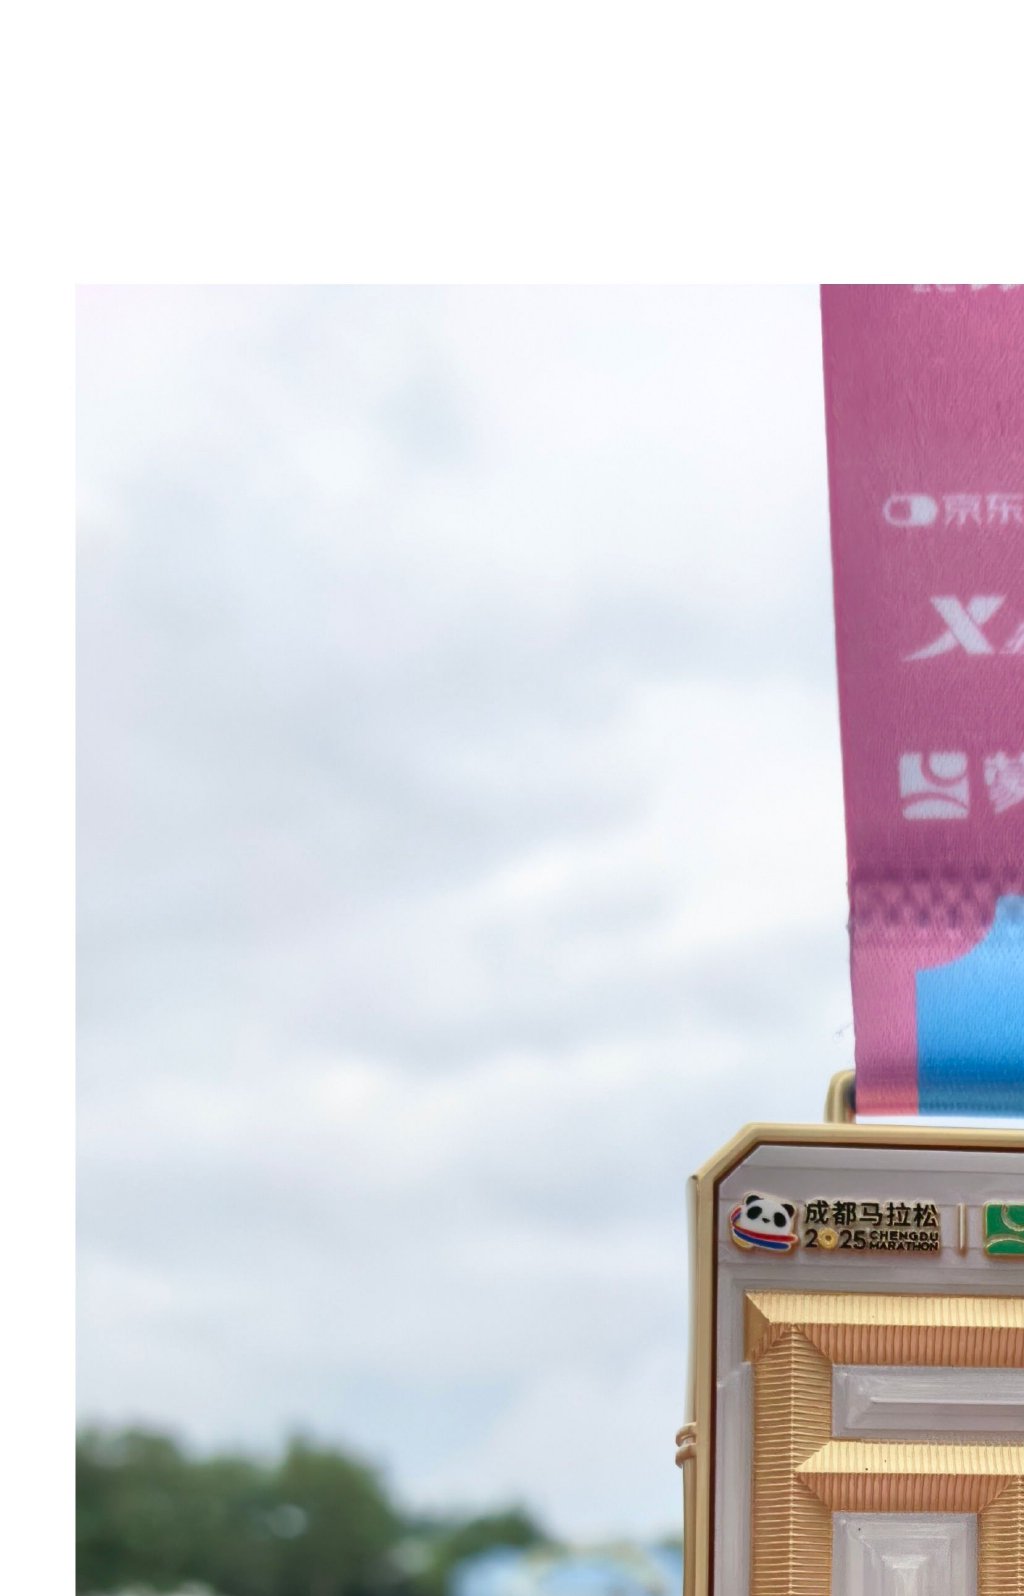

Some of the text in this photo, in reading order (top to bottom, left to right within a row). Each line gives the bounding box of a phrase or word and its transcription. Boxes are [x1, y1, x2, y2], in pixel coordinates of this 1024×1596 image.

[804, 1199, 939, 1228] 成都马拉松
[805, 1229, 939, 1250] 2025 CHENGDU
[869, 1241, 939, 1251] MARATHON
